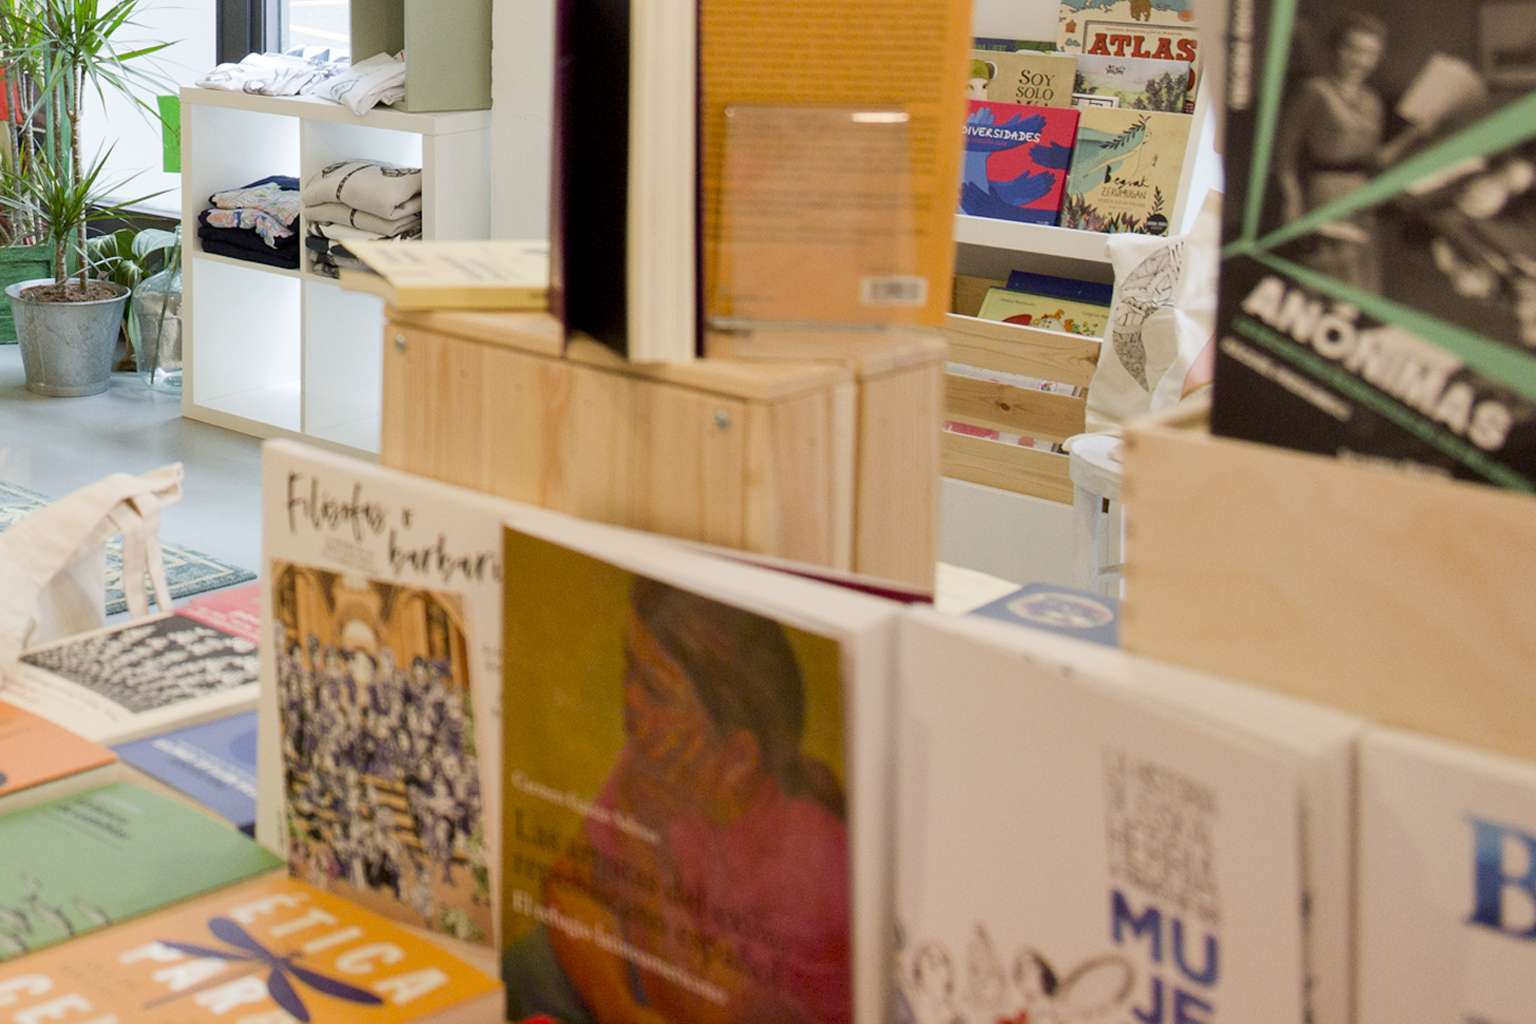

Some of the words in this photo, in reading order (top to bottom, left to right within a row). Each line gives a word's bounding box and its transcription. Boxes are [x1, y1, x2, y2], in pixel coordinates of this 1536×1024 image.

[1088, 32, 1198, 63] ATLAS
[1018, 68, 1056, 86] SOY
[1016, 85, 1054, 101] SOLO
